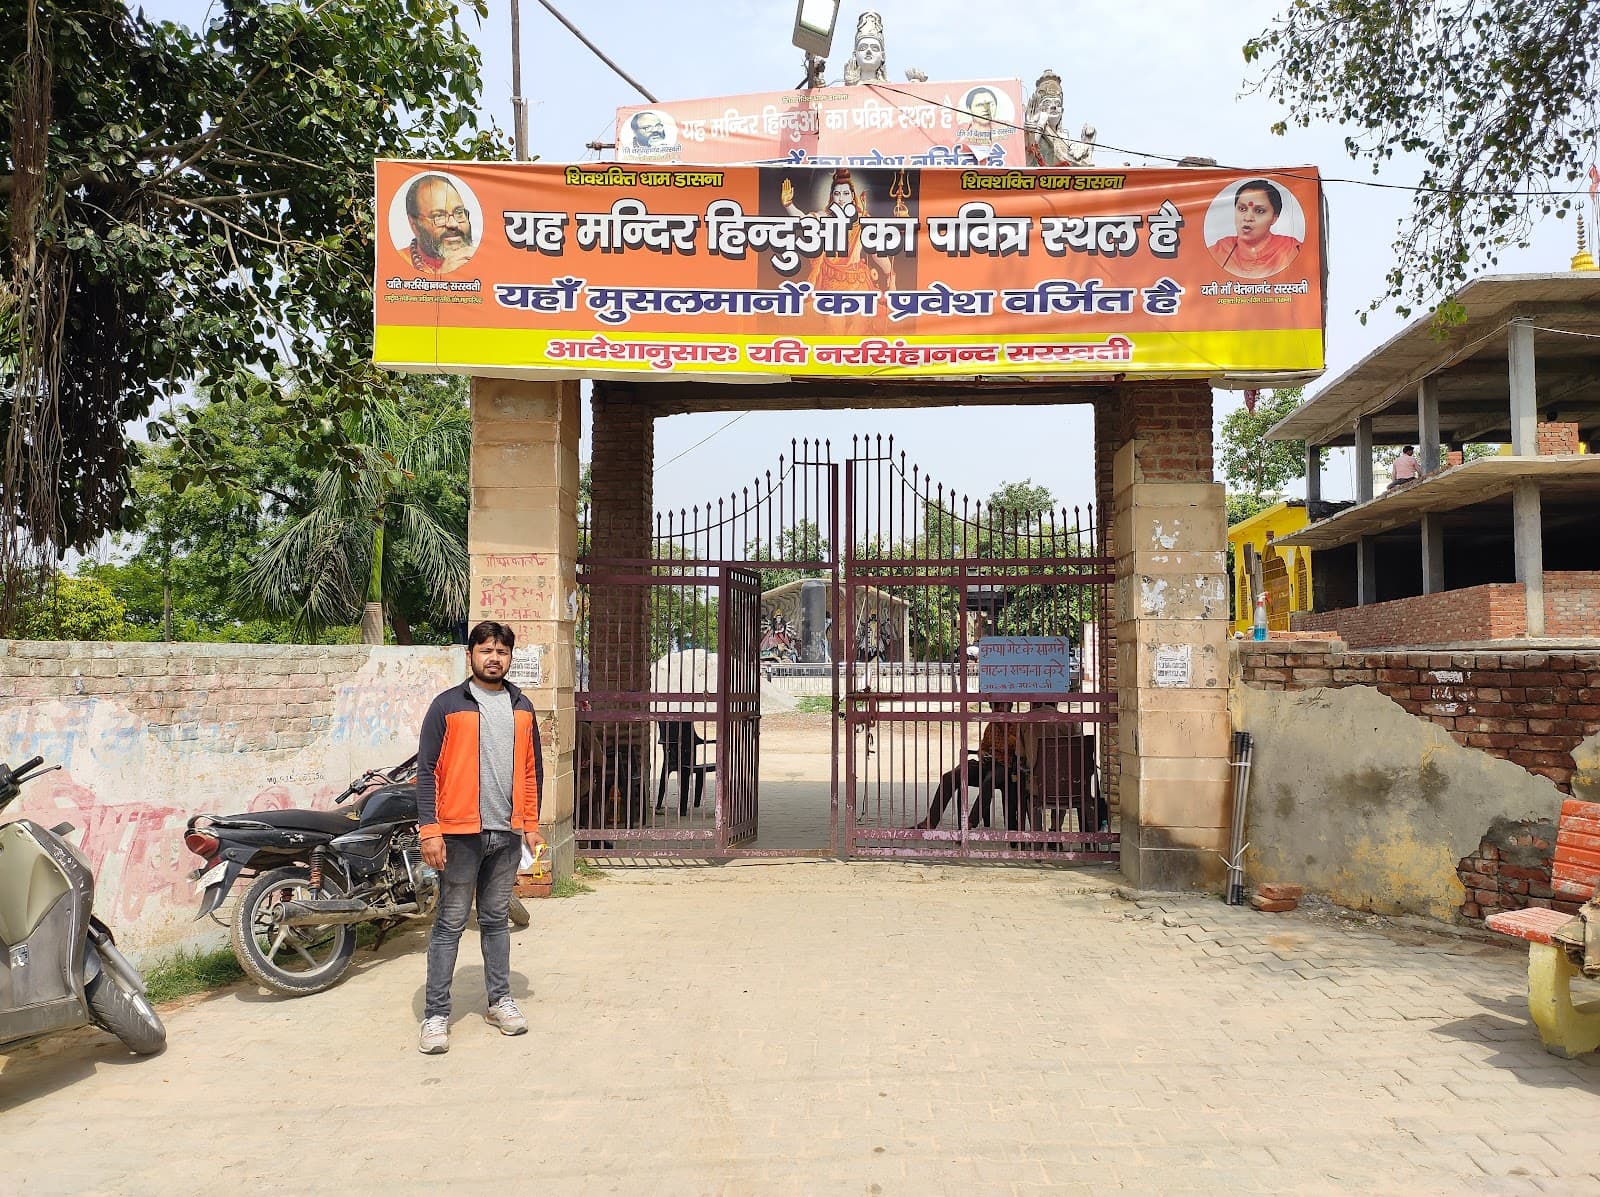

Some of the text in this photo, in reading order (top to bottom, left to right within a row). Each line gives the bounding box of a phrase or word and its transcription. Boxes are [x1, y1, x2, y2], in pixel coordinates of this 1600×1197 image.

[680, 118, 706, 143] यह
[710, 107, 760, 139] मन्दिर
[825, 108, 848, 129] का
[851, 99, 894, 129] पवित्र
[897, 104, 936, 130] स्थल
[565, 166, 724, 188] शिवशक्ति धाम डासना
[961, 170, 1126, 191] शिवशक्ति धाम डासना
[504, 199, 1184, 276] यह मन्दिर हिन्दुओं का पवित्र स्थल है
[386, 277, 403, 289] यति
[450, 279, 481, 292] सरस्वती
[1201, 279, 1309, 296] यती माँ चेतनानंद सरस्वती
[494, 273, 1184, 324] यहाँ मुसलमानों का प्रवेश वर्जित है
[747, 339, 809, 367] यति
[811, 337, 1002, 367] नरसिंहानन्द
[1006, 335, 1134, 363] सरस्वती
